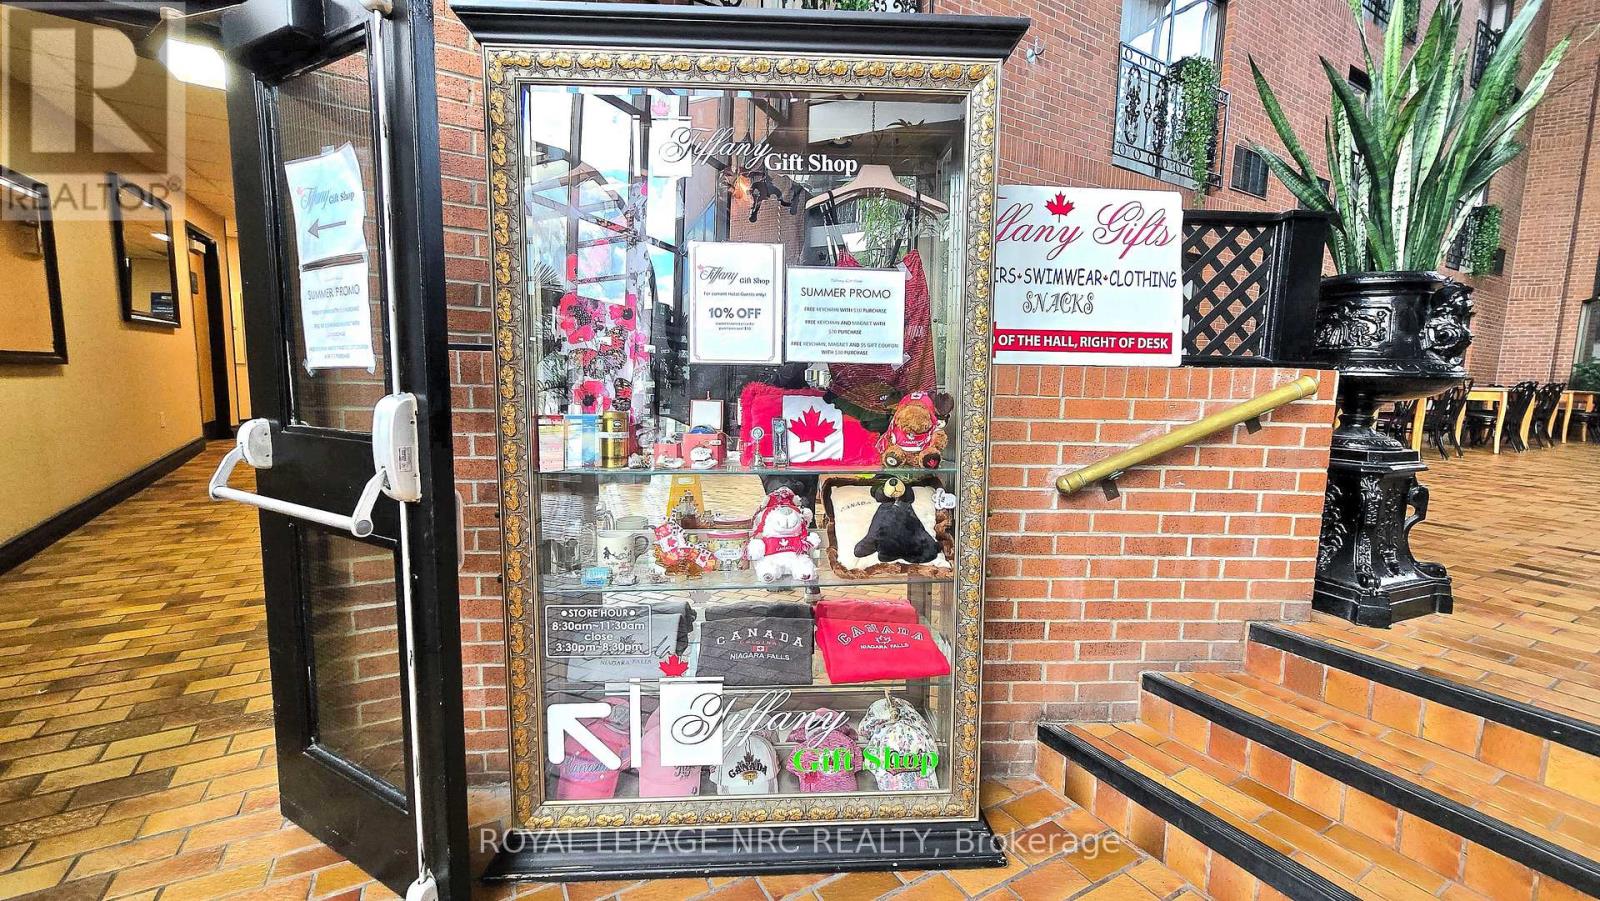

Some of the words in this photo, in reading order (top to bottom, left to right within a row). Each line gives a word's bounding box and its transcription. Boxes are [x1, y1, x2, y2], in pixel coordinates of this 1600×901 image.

[658, 126, 773, 169] Tiffany
[764, 153, 804, 172] Gift
[808, 153, 858, 178] Shop
[340, 191, 355, 203] Shop
[1092, 200, 1178, 260] Gifts
[699, 265, 739, 285] Tiffany
[753, 277, 770, 286] Shop
[1023, 268, 1103, 287] SWIMWEAR
[1109, 270, 1178, 288] CLOTHING
[307, 286, 335, 301] SUMMER
[335, 283, 361, 297] PROMO
[800, 286, 847, 298] SUMMER
[849, 288, 892, 299] PROMO
[1022, 290, 1095, 316] SNACKS
[708, 307, 735, 319] 10%
[736, 307, 762, 319] OFF
[998, 334, 1016, 347] OF
[1017, 335, 1041, 347] THE
[1043, 336, 1078, 349] HALL,
[1079, 336, 1117, 349] RIGHT
[1118, 338, 1135, 349] OF
[1138, 338, 1169, 350] DESK
[568, 609, 598, 618] STORE
[600, 609, 628, 618] HOUR
[551, 621, 645, 631] 8:30am~11:30am
[837, 623, 924, 646] CANADA
[584, 632, 614, 641] close
[716, 628, 804, 648] CANADA
[555, 643, 643, 653] 3:30pm~8:30pm
[730, 651, 767, 660] NIAGARA
[767, 652, 790, 661] FALLS
[670, 688, 851, 749] Tiffany
[791, 746, 854, 773] Gift
[862, 745, 940, 778] Shop
